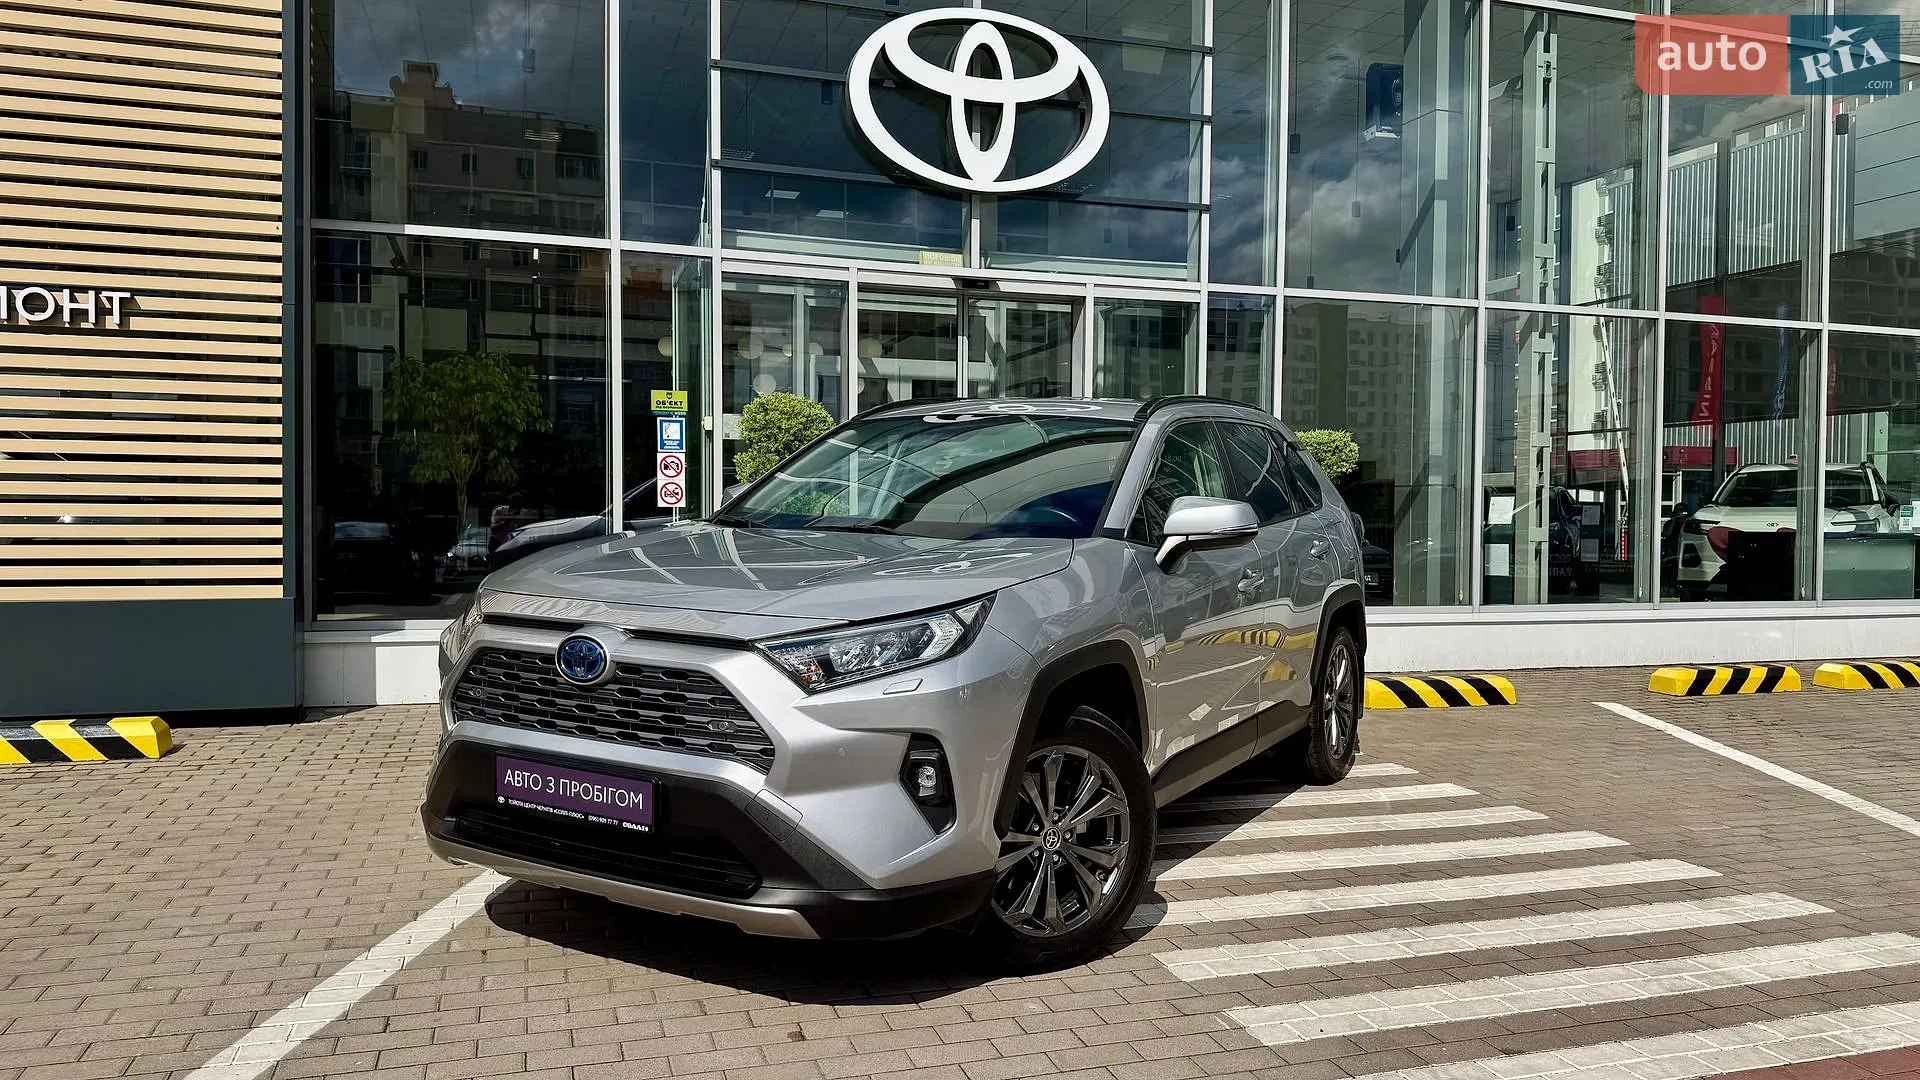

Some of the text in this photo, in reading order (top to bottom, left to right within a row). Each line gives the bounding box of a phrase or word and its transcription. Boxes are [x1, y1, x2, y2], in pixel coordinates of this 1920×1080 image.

[504, 769, 642, 810] АВТО З ПРОБІГОМ
